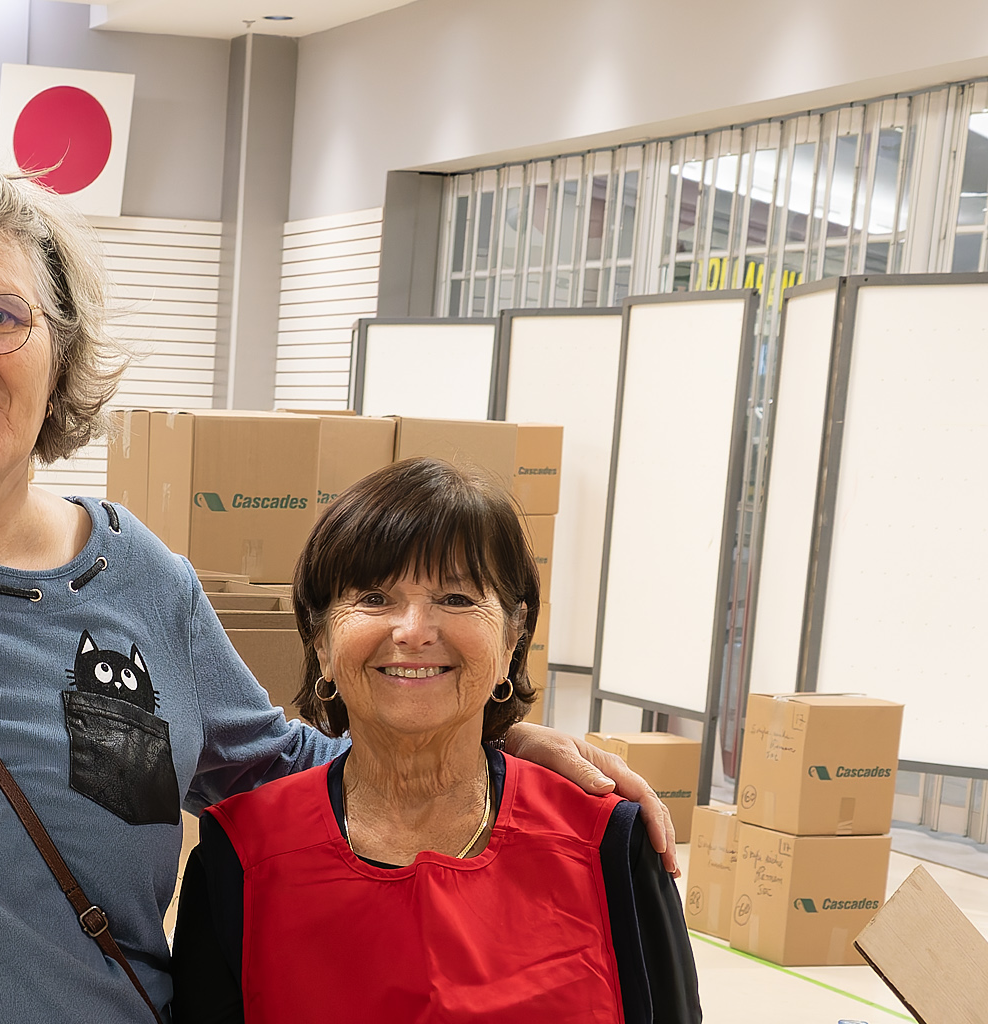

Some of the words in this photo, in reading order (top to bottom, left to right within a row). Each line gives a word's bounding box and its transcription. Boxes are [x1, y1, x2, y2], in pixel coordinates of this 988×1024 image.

[231, 493, 308, 509] Cascades
[835, 766, 891, 778] Cascades
[656, 789, 691, 798] ascades
[822, 897, 879, 910] Cascades
